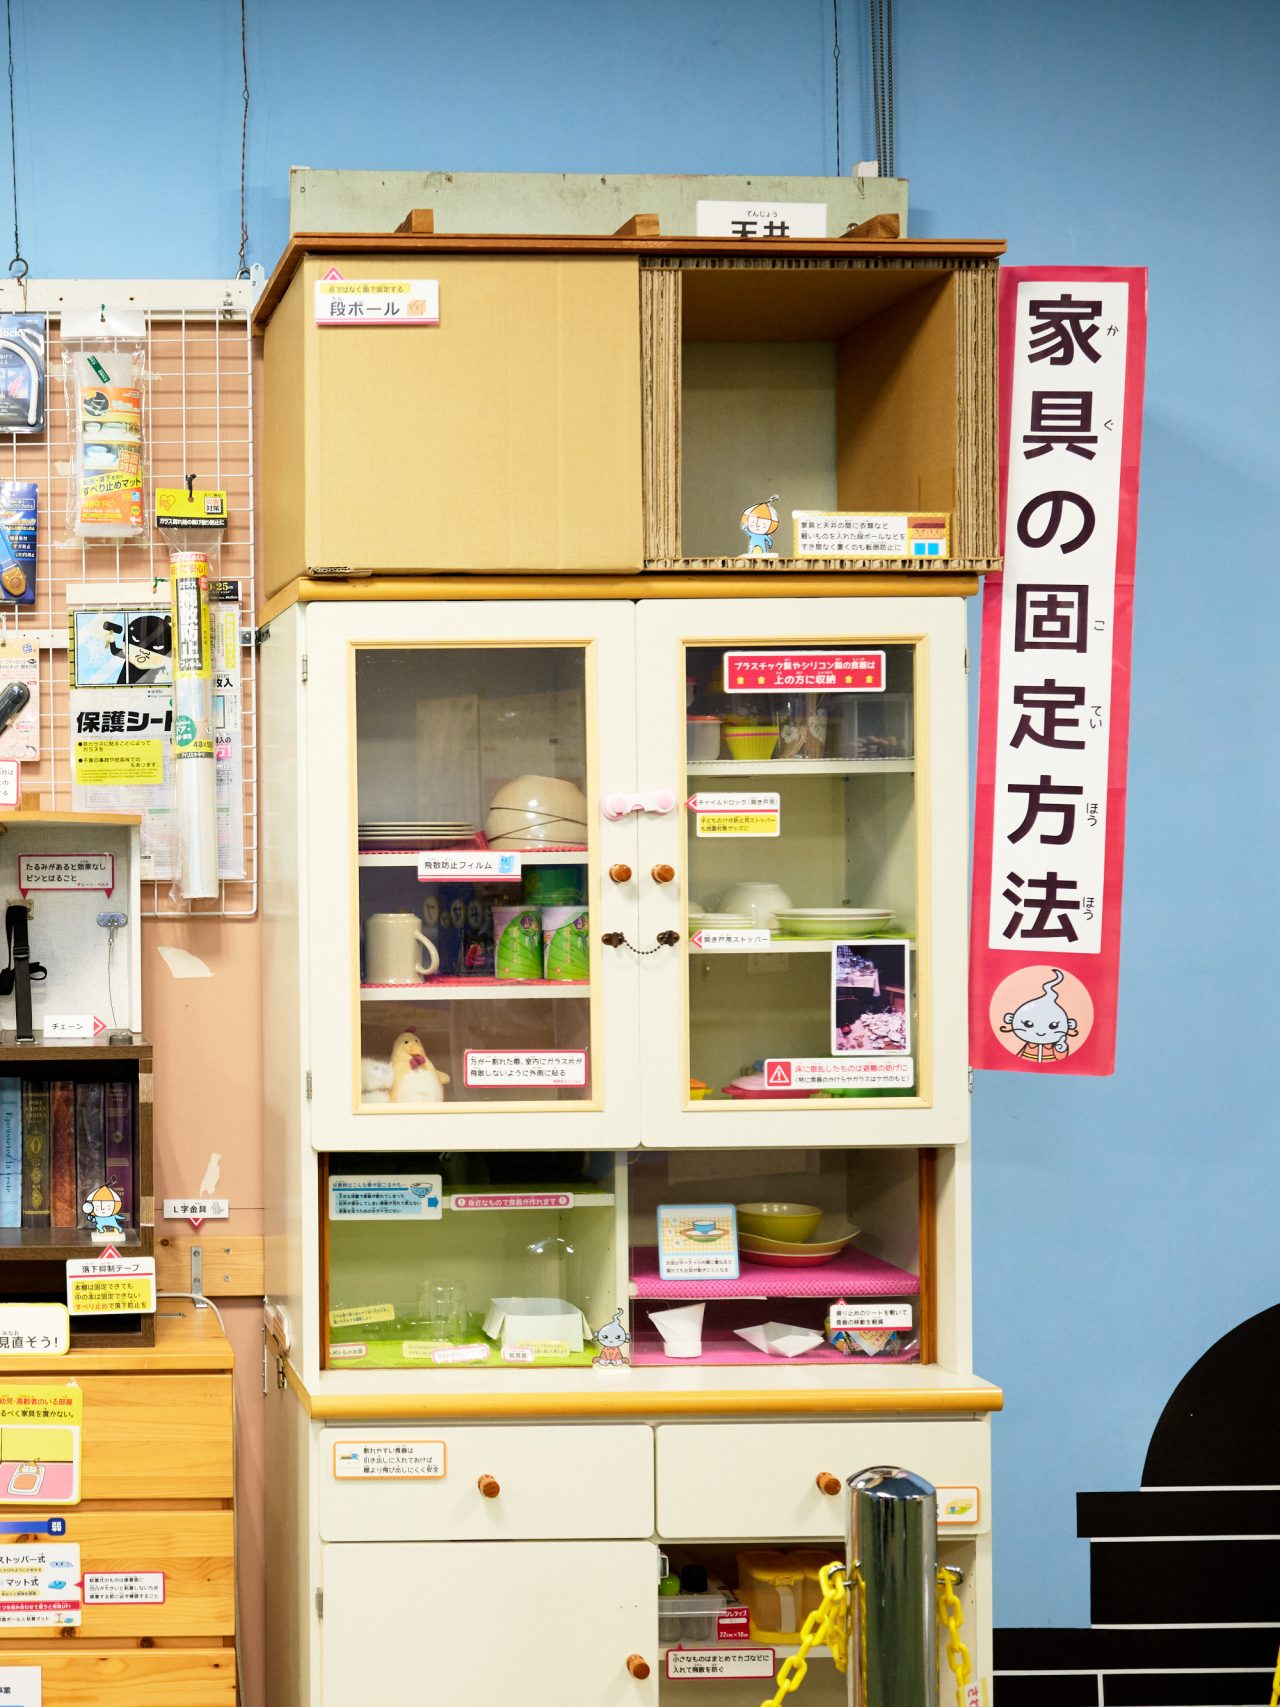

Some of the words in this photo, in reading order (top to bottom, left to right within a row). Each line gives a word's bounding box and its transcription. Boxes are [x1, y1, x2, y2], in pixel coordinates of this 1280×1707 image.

[330, 301, 400, 317] 段ボール
[1107, 325, 1119, 337] か
[801, 521, 888, 530] 家具と天井の間に衣類など
[1002, 294, 1103, 943] 家具の固定方法
[1094, 621, 1105, 631] こ
[734, 661, 876, 671] プラスチック製やシリコン製の食器は
[774, 674, 837, 685] 上の方に収納
[26, 863, 106, 871] たるみがあると効果なし
[424, 861, 492, 870] 飛散防止フィルム
[173, 1206, 207, 1214] L字金具
[81, 1264, 140, 1273] 落下抑制テープ
[51, 1522, 62, 1532] 弱
[6, 1578, 39, 1587] マット式
[673, 1655, 770, 1663] 小さなものはまとめてカゴなどに
